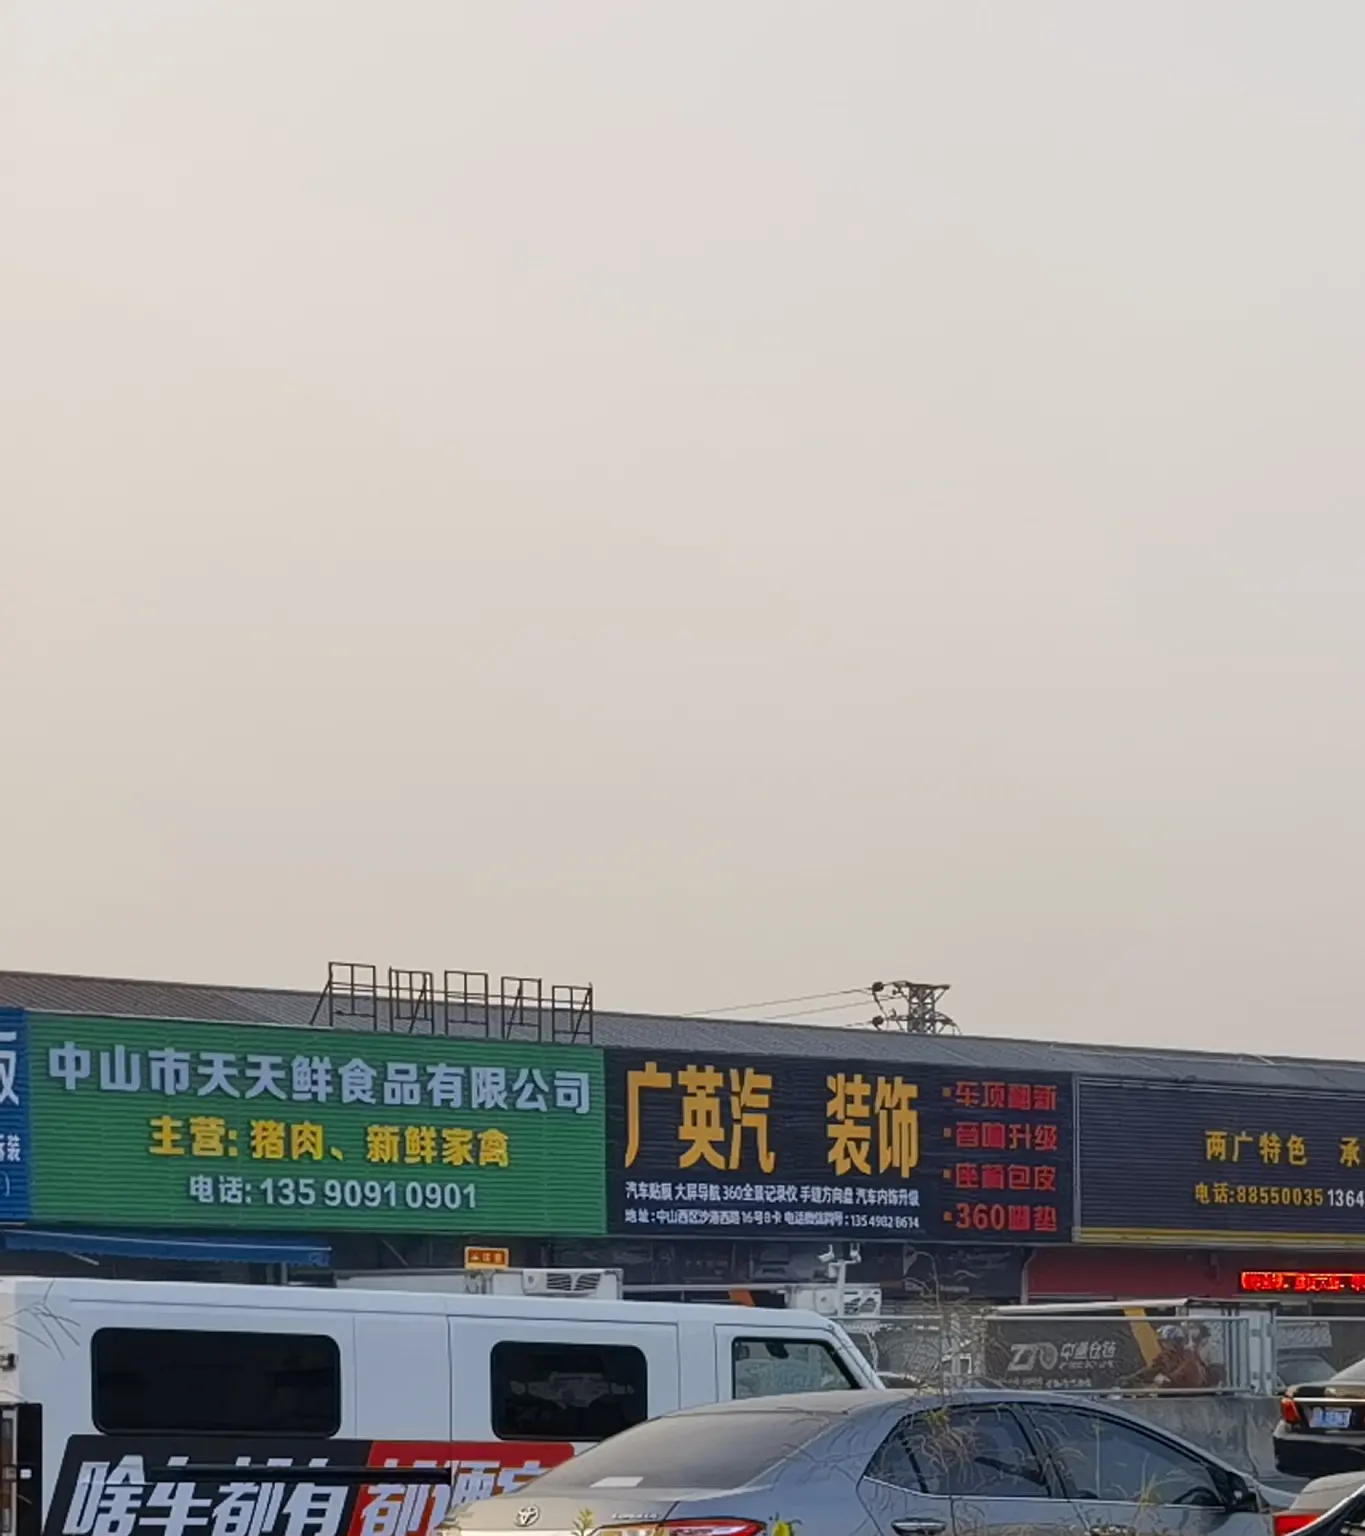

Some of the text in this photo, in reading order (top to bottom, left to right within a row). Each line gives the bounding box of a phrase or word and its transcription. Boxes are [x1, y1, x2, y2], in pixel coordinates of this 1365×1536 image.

[50, 1041, 590, 1114] 中山市天天鲜食品有限公司
[624, 1062, 919, 1178] 广英汽 装饰
[1205, 1130, 1307, 1166] 两广特色
